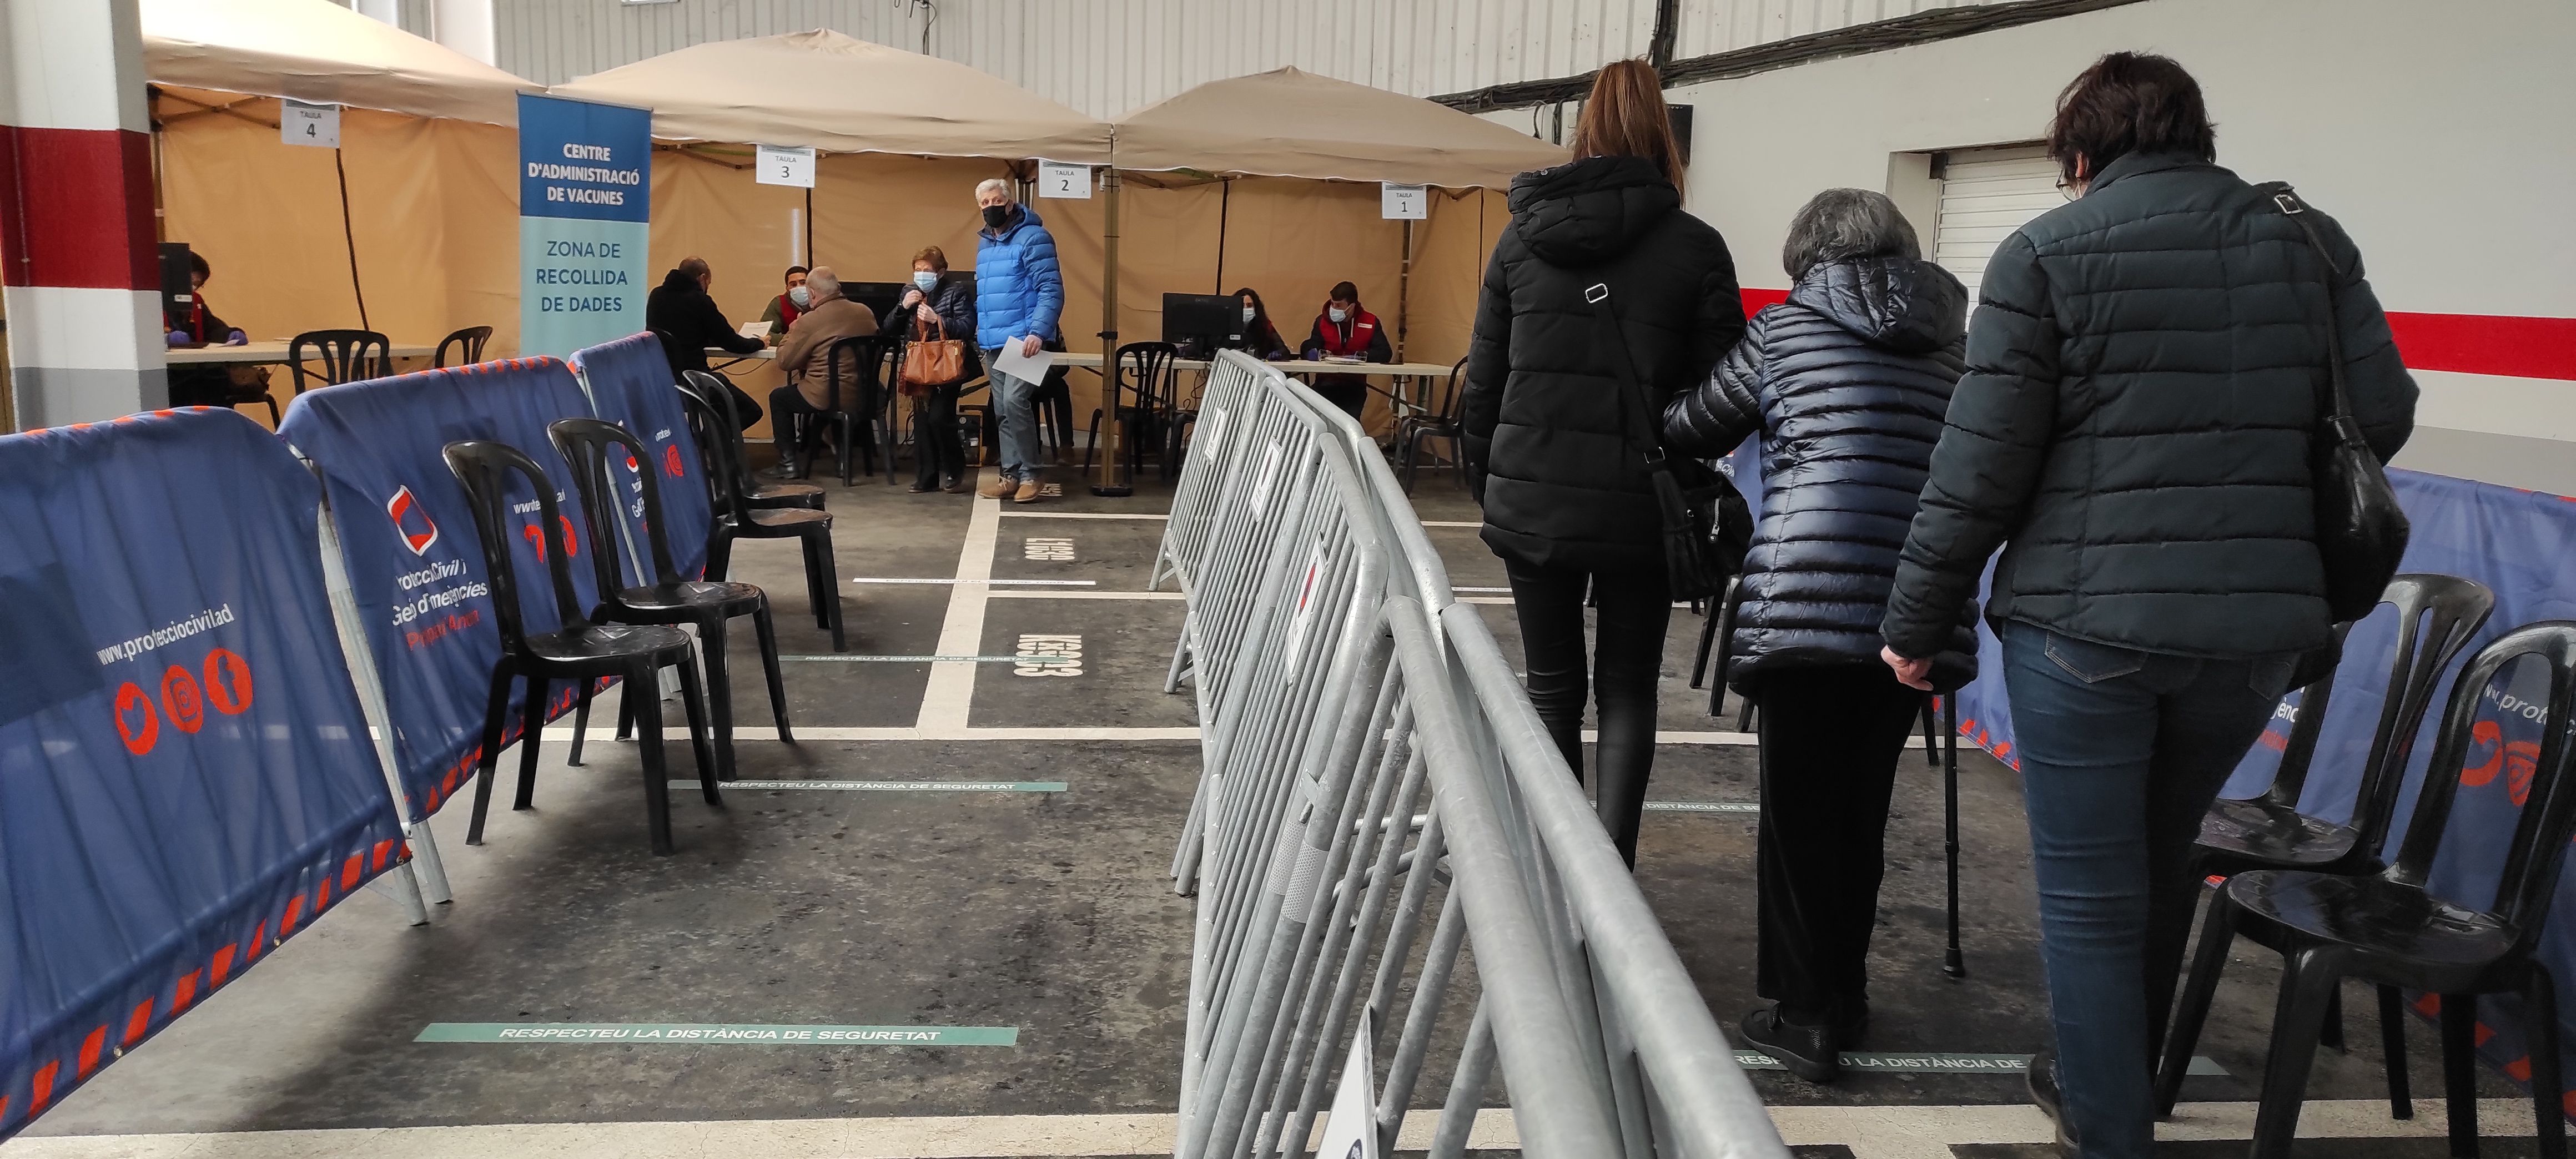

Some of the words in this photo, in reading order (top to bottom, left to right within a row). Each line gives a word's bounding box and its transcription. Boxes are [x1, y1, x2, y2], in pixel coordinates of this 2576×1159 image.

[306, 123, 316, 138] 4
[563, 143, 611, 162] CENTRE
[528, 162, 640, 185] D'ADMINISTRACIÓ
[781, 166, 789, 178] 3
[1061, 179, 1069, 192] 2
[547, 187, 565, 202] DE
[567, 188, 624, 206] VACUNES
[1401, 201, 1408, 213] 1
[547, 240, 596, 258] ZONA
[600, 243, 621, 258] DE
[536, 269, 628, 285] RECOLLIDA
[541, 296, 564, 312] DE
[569, 296, 622, 312] DADES
[96, 603, 235, 666] www.protecciocivil.ad
[1013, 634, 1084, 677] K8903
[500, 1029, 631, 1038] RESPECTEU
[633, 1029, 661, 1039] LA
[666, 1027, 777, 1040] DISTÀNCIA
[782, 1030, 812, 1040] DE
[817, 1030, 941, 1040] SEGURETAT
[1855, 1057, 1886, 1067] LA
[1885, 1056, 1997, 1069] DISTÀNCIA
[1995, 1059, 2029, 1069] DE
